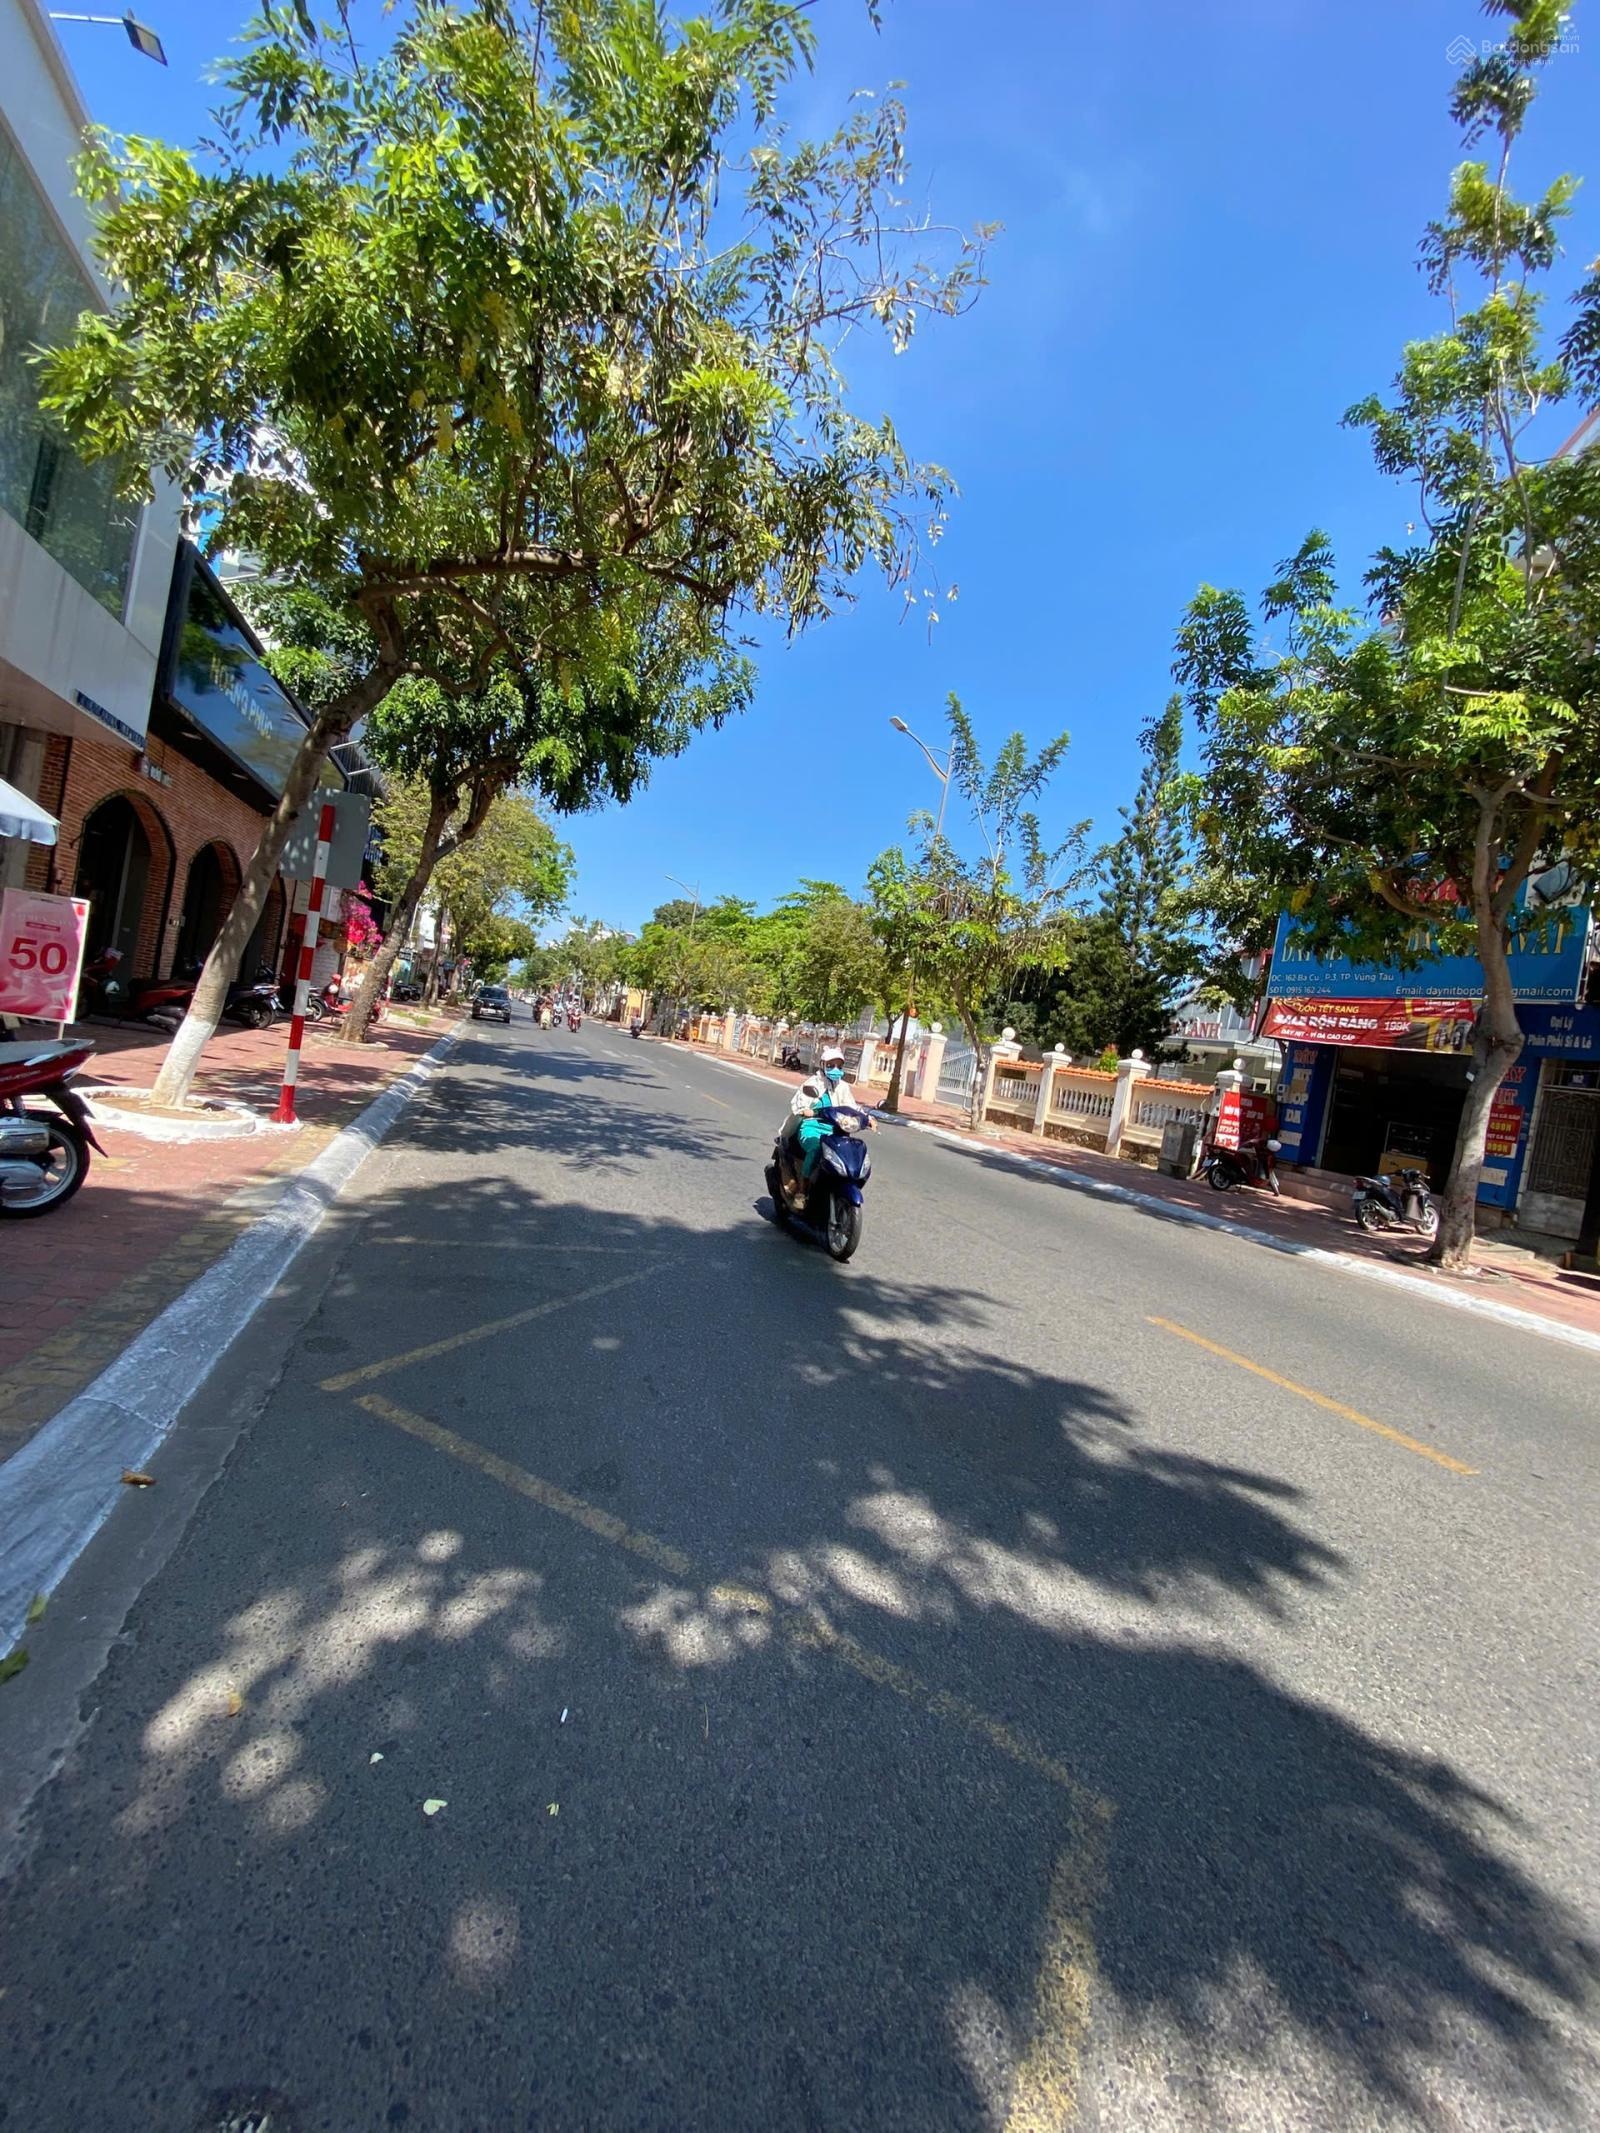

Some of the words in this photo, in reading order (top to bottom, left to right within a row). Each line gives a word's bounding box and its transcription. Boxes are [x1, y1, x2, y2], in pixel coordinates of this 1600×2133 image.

[8, 937, 68, 975] 50
[1395, 986, 1423, 995] Email:
[1384, 1021, 1411, 1032] 199K
